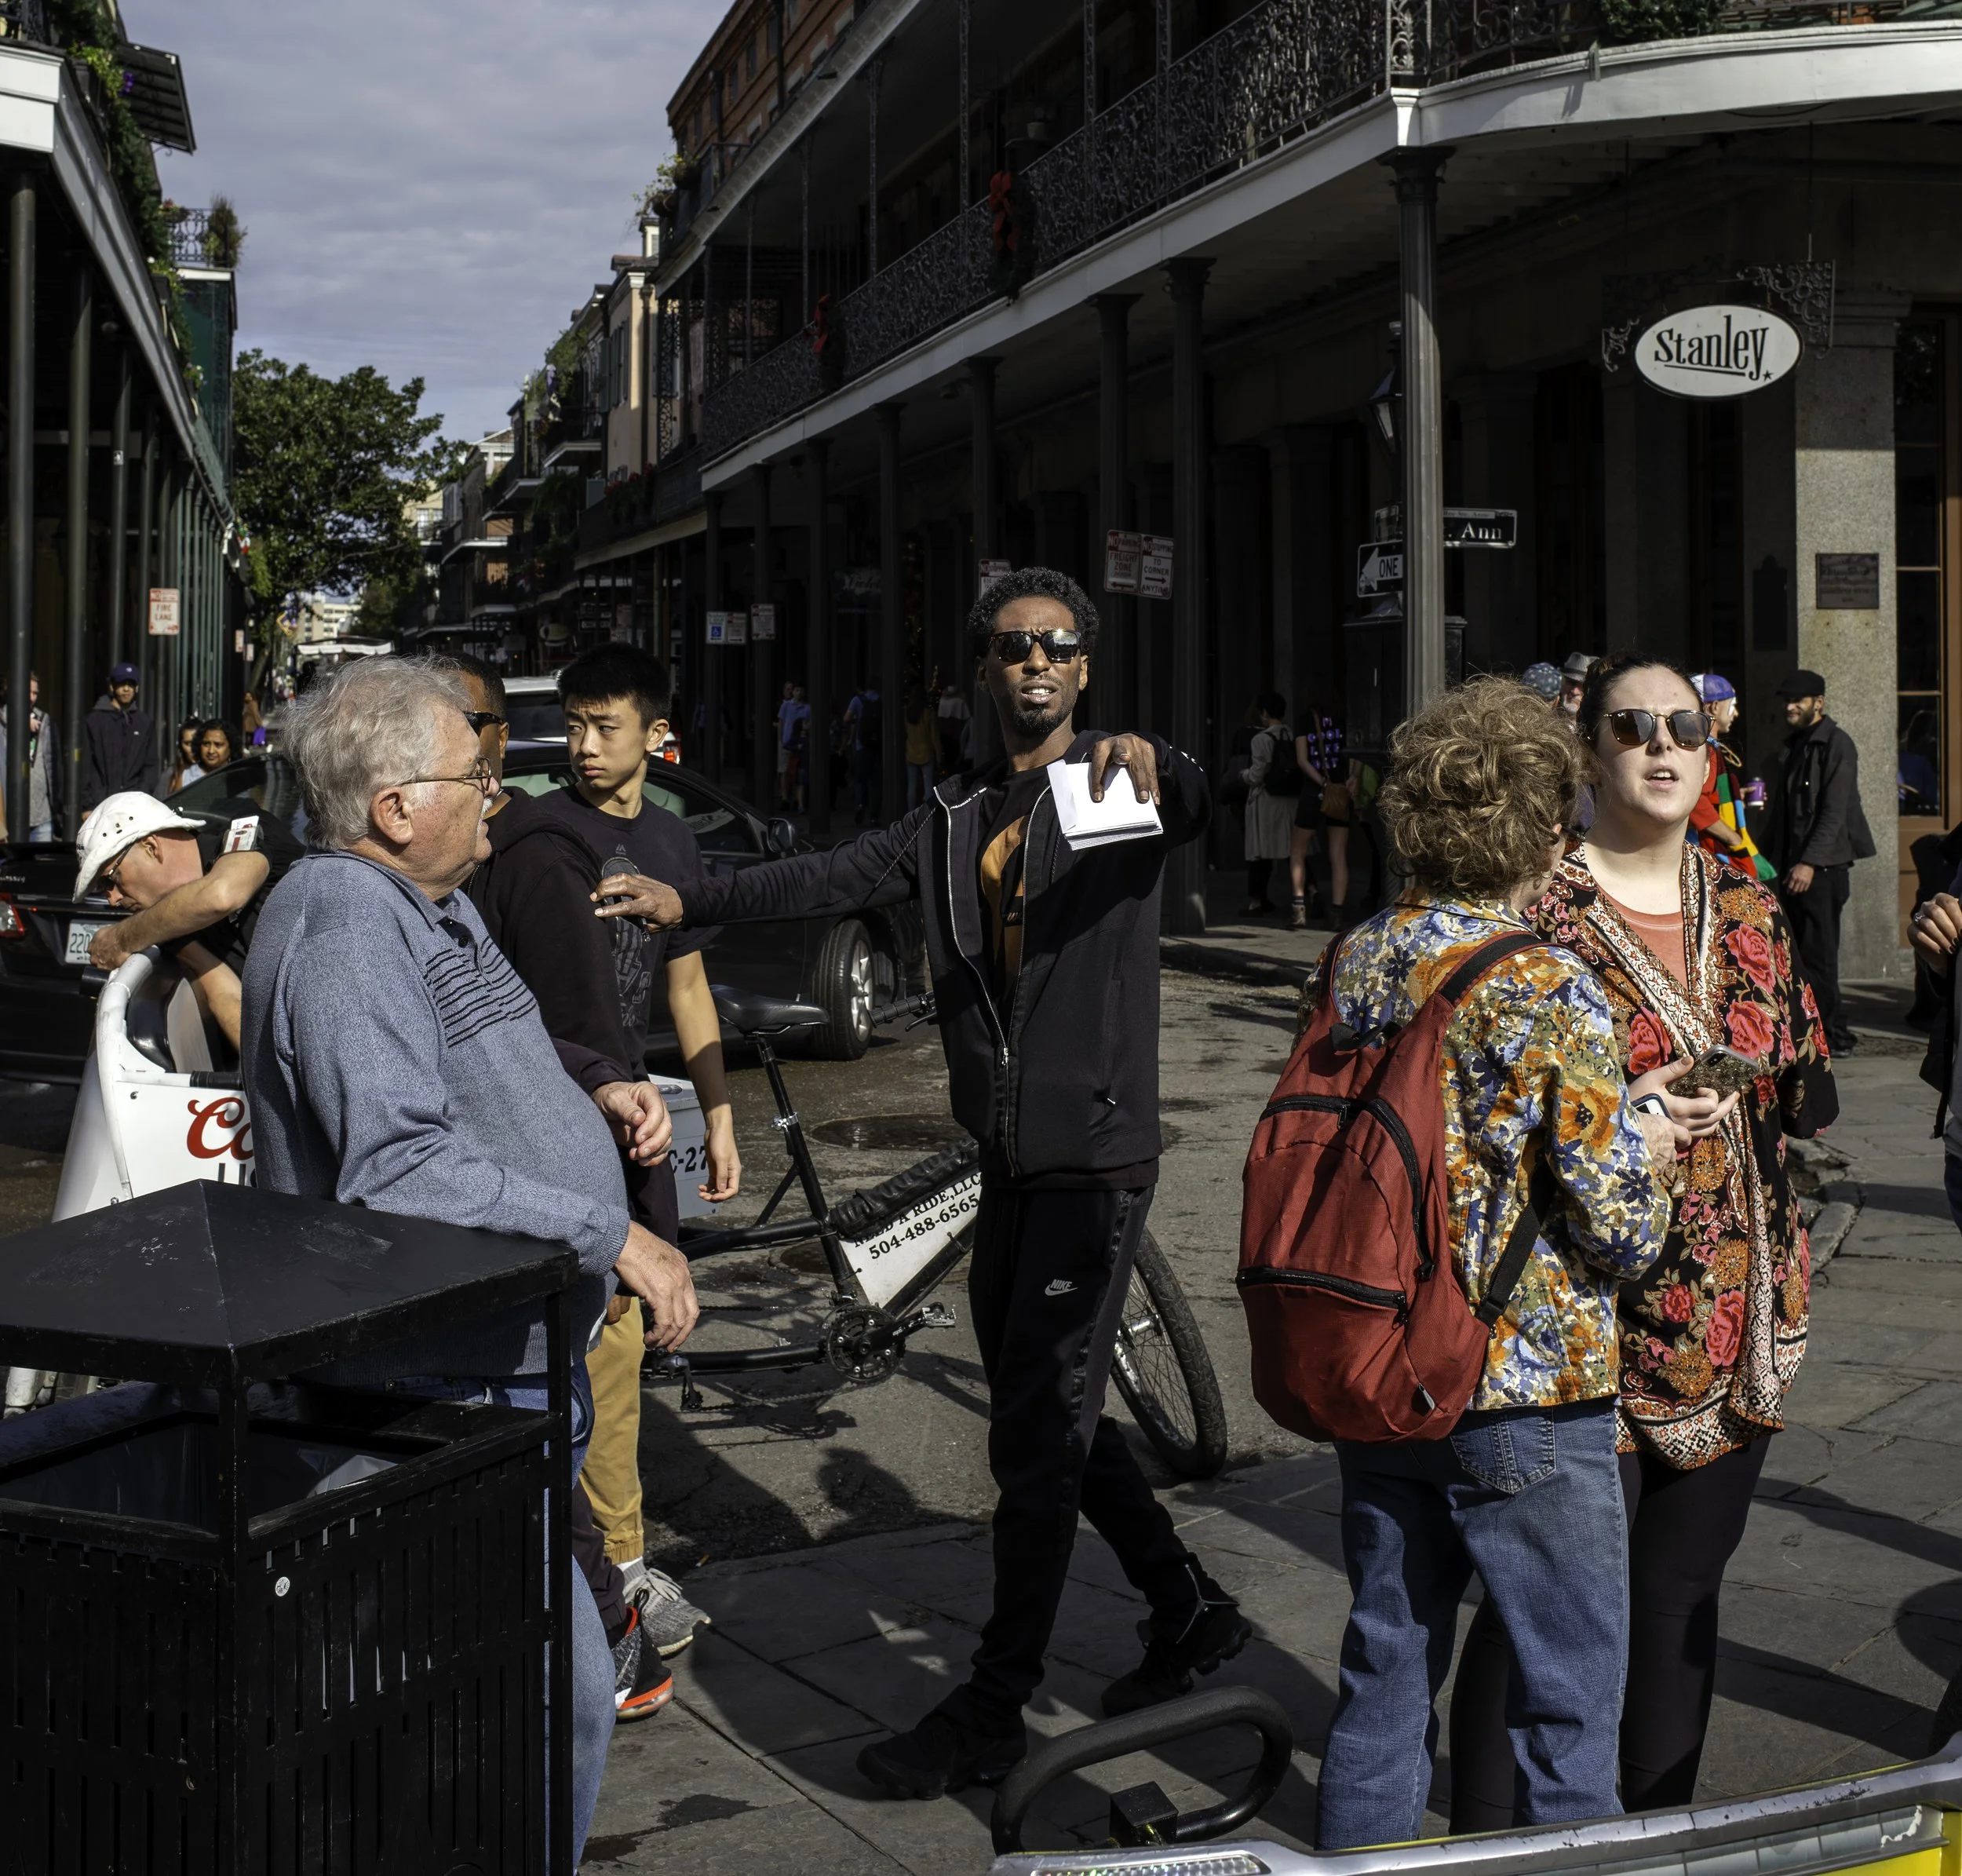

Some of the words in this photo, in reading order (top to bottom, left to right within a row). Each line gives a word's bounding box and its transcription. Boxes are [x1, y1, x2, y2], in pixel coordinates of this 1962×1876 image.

[1654, 315, 1769, 381] Stanley
[1461, 521, 1502, 539] Ann
[1108, 535, 1118, 547] NO
[1143, 540, 1152, 551] NO
[1114, 561, 1132, 571] ZONE
[1143, 566, 1169, 575] CORNER
[1379, 557, 1399, 578] ONE
[869, 1193, 979, 1259] 504-488-6565
[1050, 1279, 1073, 1290] NIKE
